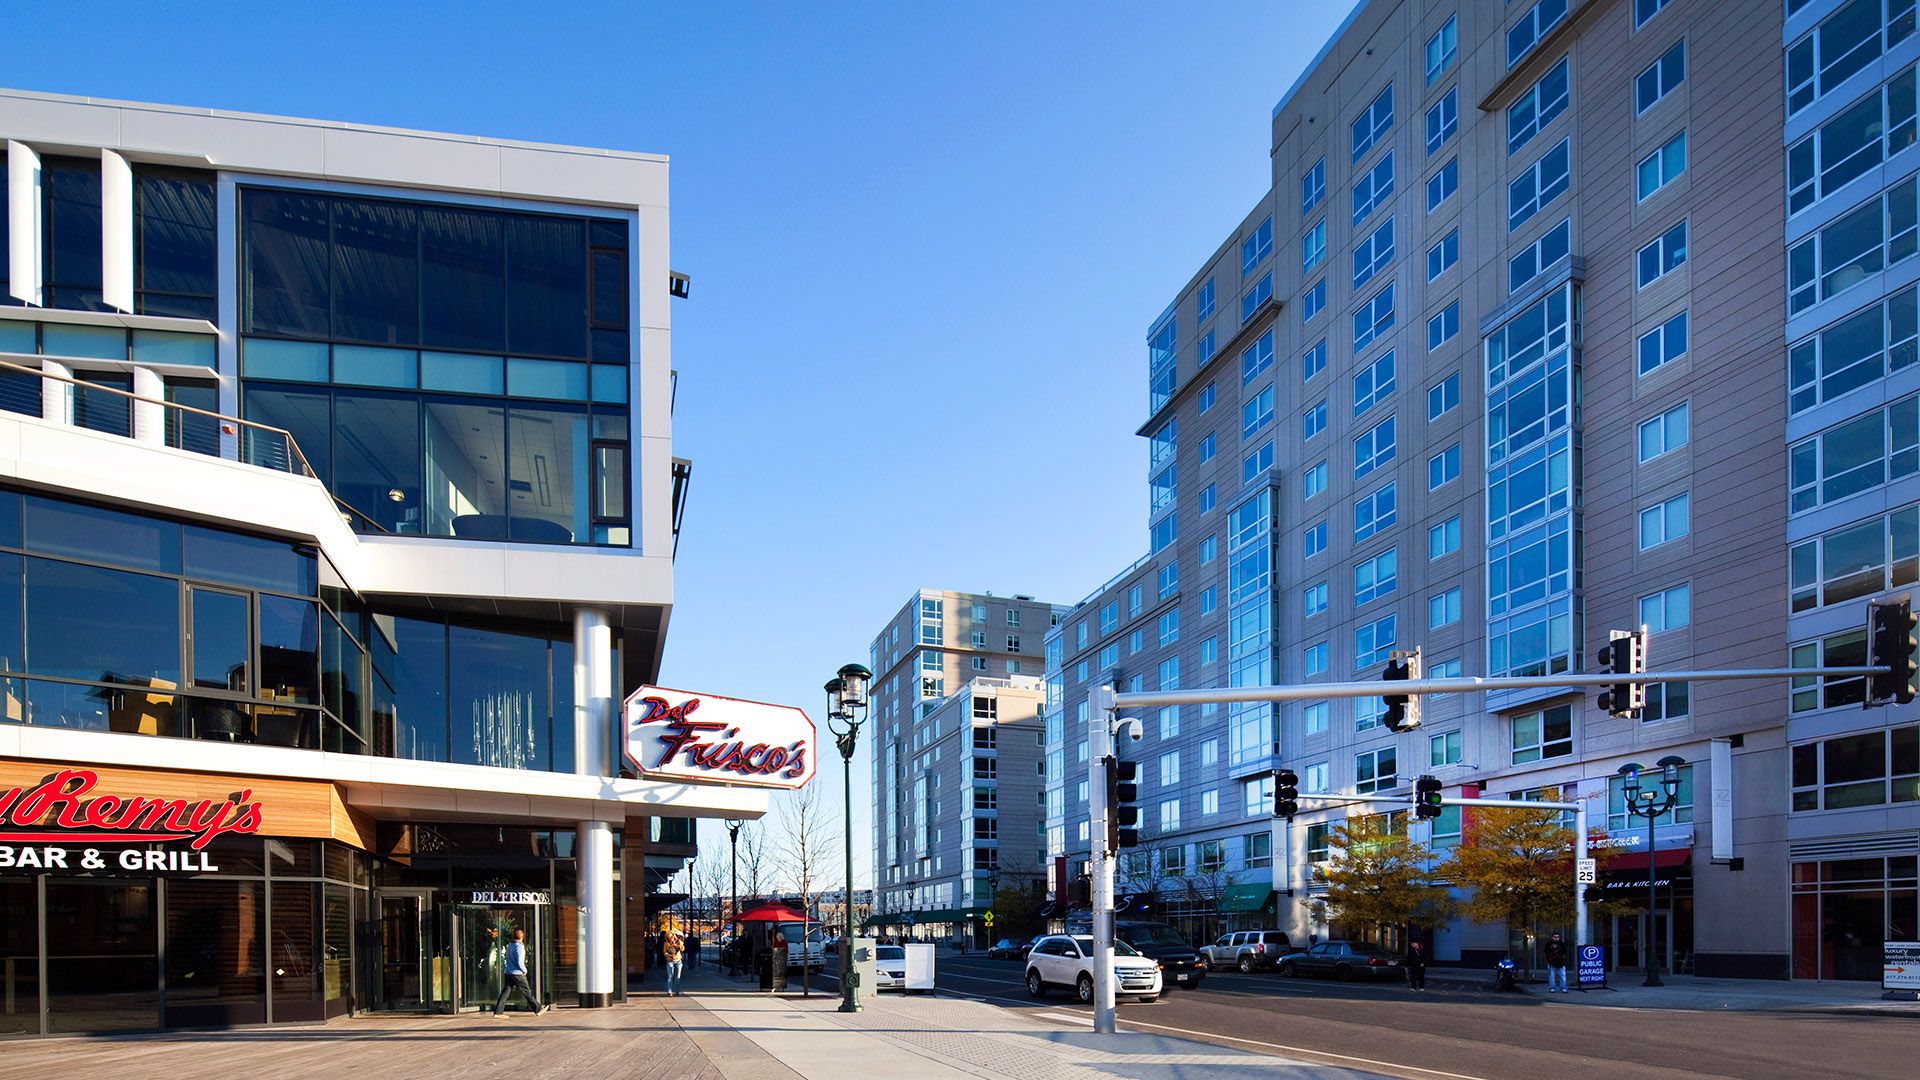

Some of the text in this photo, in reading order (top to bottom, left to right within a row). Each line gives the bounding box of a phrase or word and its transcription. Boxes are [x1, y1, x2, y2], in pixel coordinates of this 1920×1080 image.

[640, 696, 701, 723] Del
[657, 720, 807, 778] Frisco's
[12, 769, 264, 850] Remy's
[0, 846, 219, 872] BAR & GRILL
[1578, 871, 1594, 882] 25
[472, 891, 495, 904] DEL
